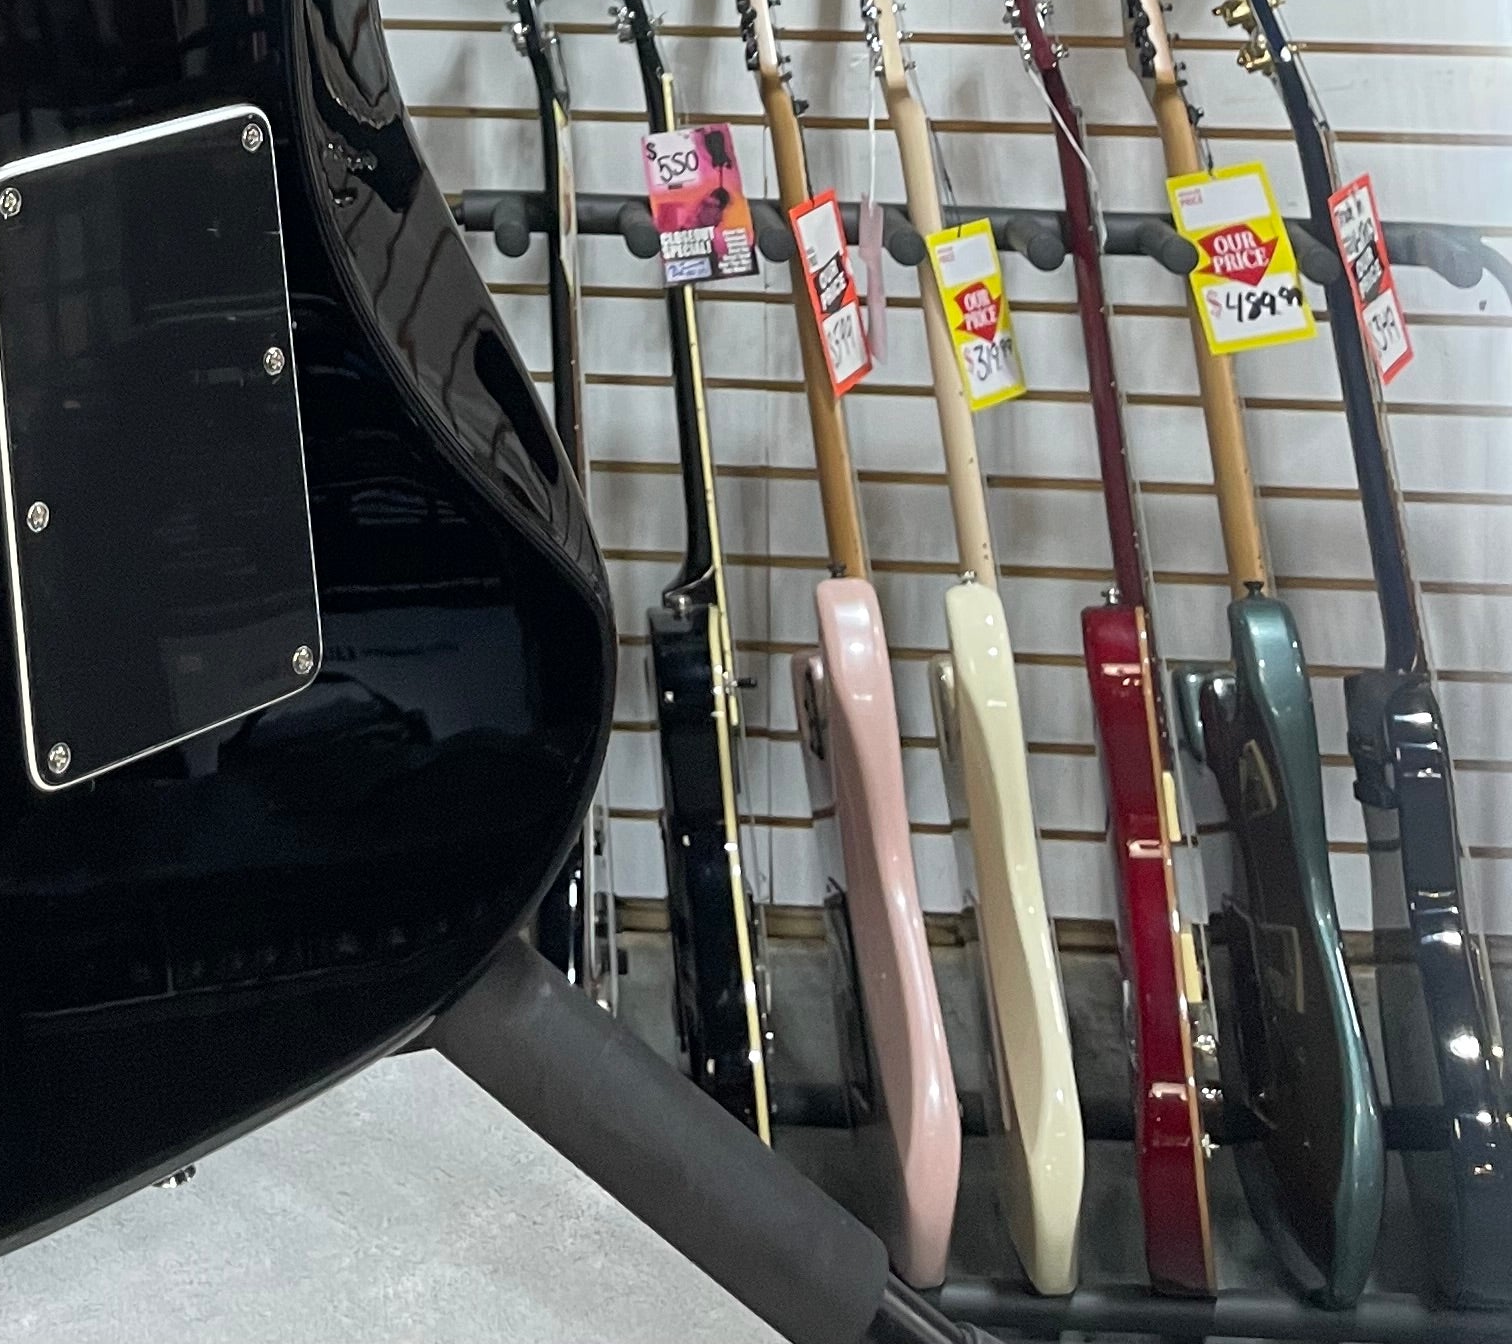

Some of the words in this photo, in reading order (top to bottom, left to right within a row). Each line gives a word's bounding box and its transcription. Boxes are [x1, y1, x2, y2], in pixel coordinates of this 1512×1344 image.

[1212, 230, 1258, 255] OUR
[1211, 247, 1270, 275] PRICE
[963, 287, 990, 310] OUR
[963, 305, 999, 332] PRICE
